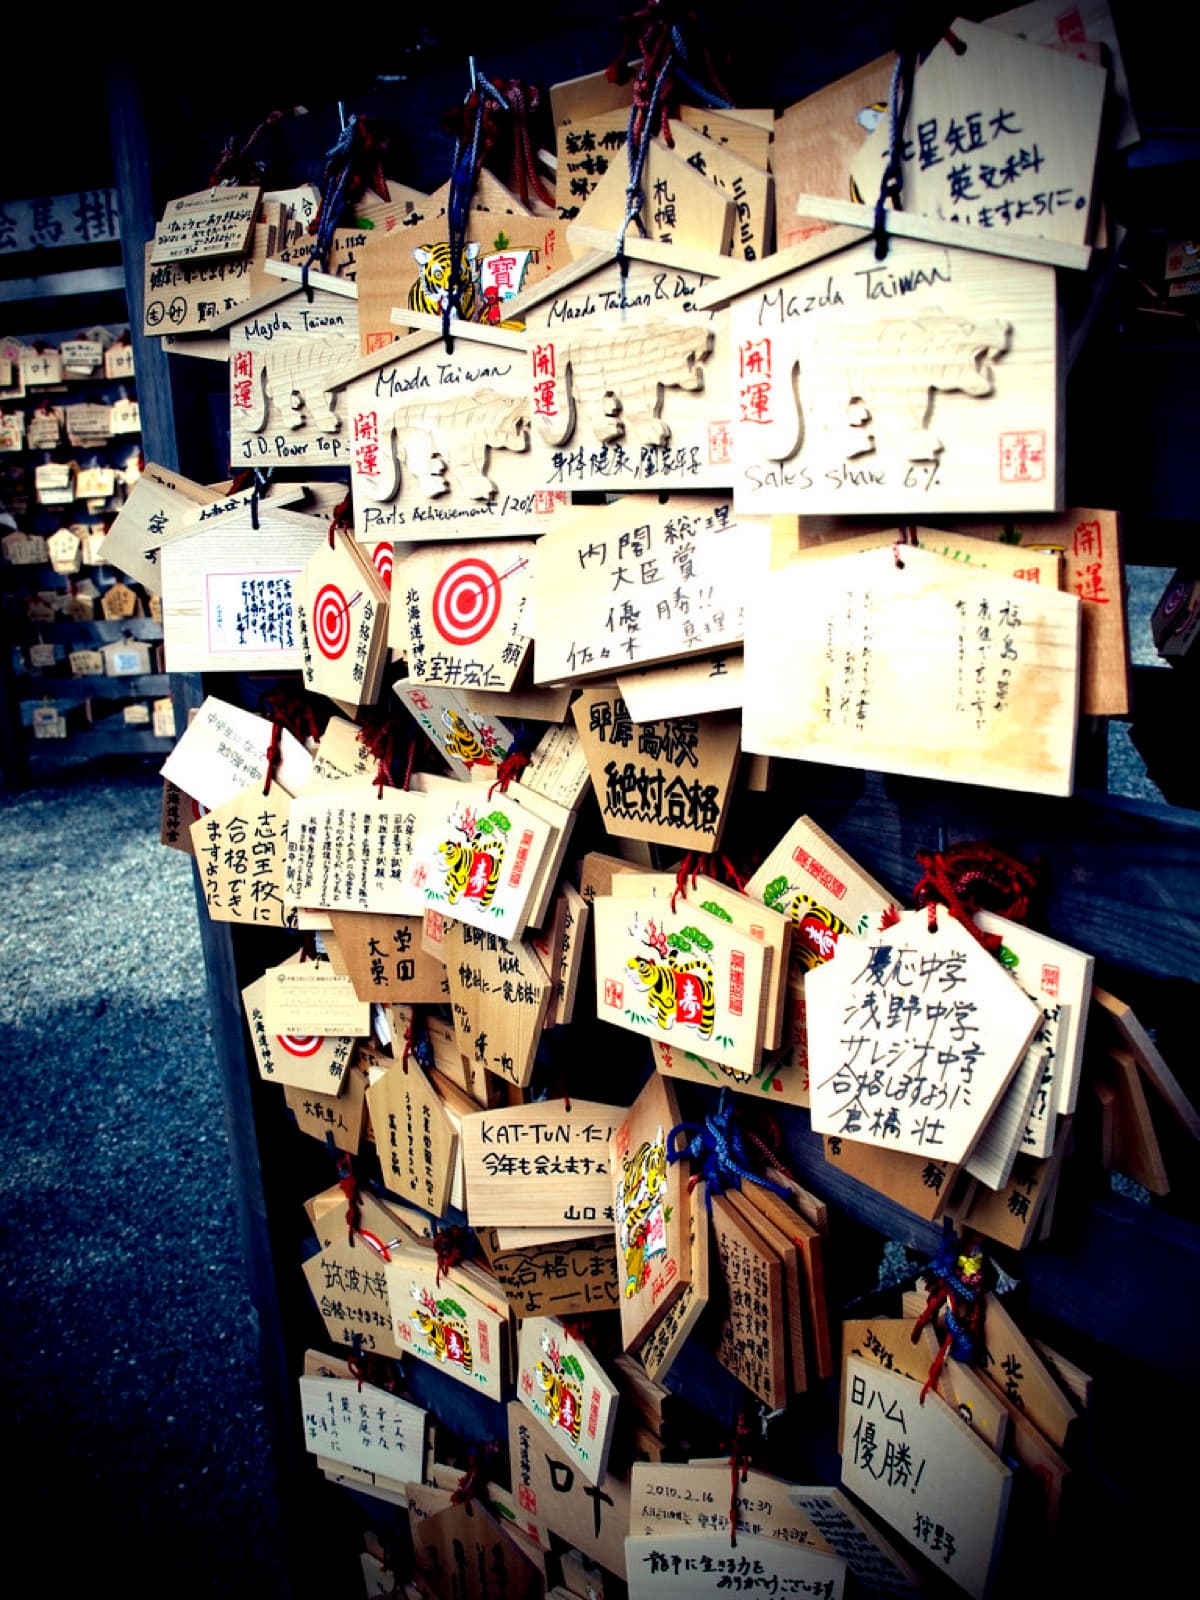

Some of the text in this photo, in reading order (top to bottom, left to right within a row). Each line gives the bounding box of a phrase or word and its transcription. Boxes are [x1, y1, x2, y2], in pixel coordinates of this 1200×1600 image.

[300, 311, 344, 332] Taiwan
[547, 296, 595, 327] Mazda
[599, 291, 650, 310] Taiwan
[758, 277, 844, 326] Mazda
[233, 351, 254, 409] 開運
[375, 364, 512, 397] Mazda Taiwan
[532, 343, 559, 417] 開運
[739, 338, 773, 425] 開運
[275, 436, 308, 458] Power
[354, 411, 381, 477] 開運
[744, 464, 814, 490] Sales
[363, 505, 406, 533] Parts
[578, 505, 738, 569] 内閣総理
[611, 541, 698, 591] 大臣賞
[1074, 520, 1111, 604] 開運
[604, 761, 721, 825] 絶対合格
[201, 820, 223, 908] ますように
[225, 817, 249, 917] 合格でき
[852, 940, 968, 993] 慶応中学
[679, 979, 701, 1019] 寿
[844, 990, 980, 1042] 浅野中学
[840, 1035, 986, 1084] サレジオ中学
[817, 1062, 973, 1111] 合格しますように
[481, 1153, 612, 1178] 今年も会えますよ
[320, 1258, 388, 1299] 筑波大学
[851, 1375, 908, 1435] 日ハム
[853, 1415, 926, 1495] 優勝!
[647, 1484, 714, 1503] 2010.2.16
